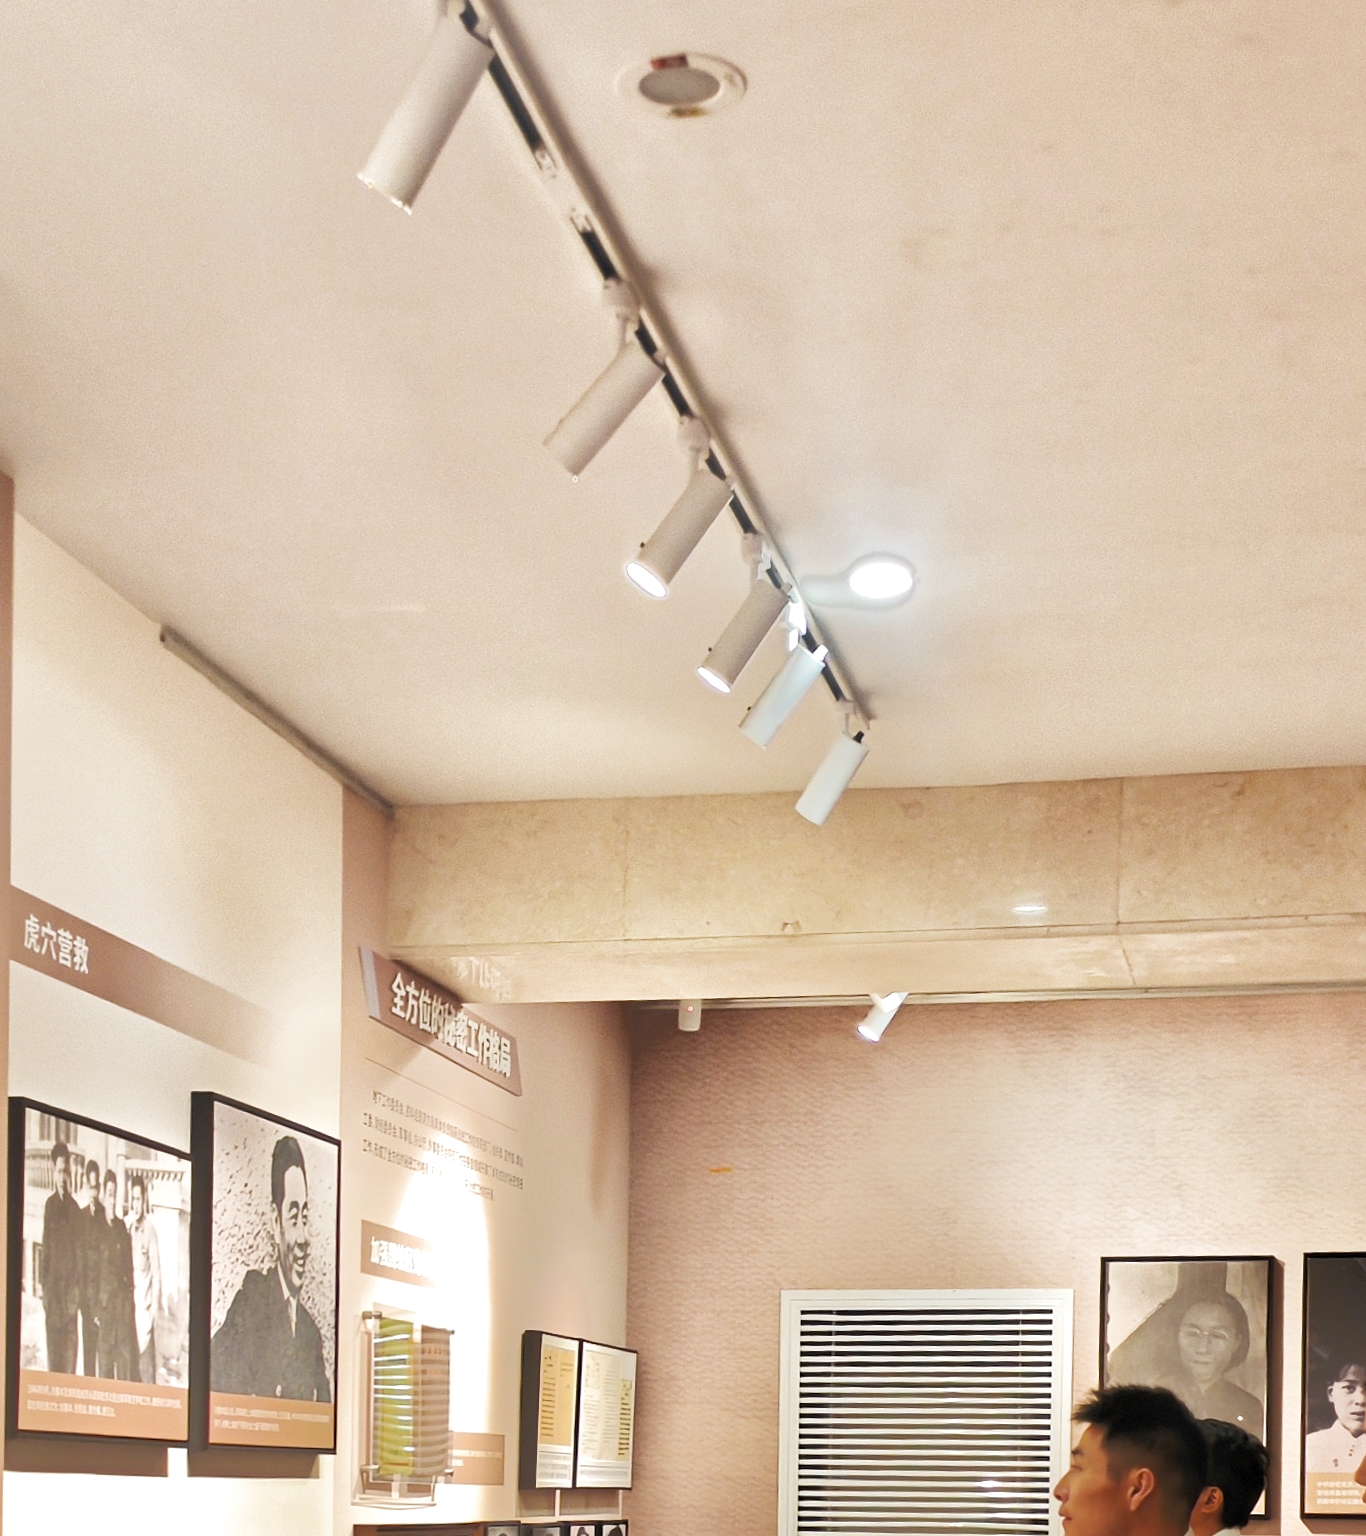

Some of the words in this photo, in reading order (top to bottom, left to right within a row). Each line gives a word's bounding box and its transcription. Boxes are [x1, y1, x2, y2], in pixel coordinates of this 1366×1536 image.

[23, 914, 89, 974] 虎穴营救
[391, 972, 512, 1078] 全方位的秘密工作格局
